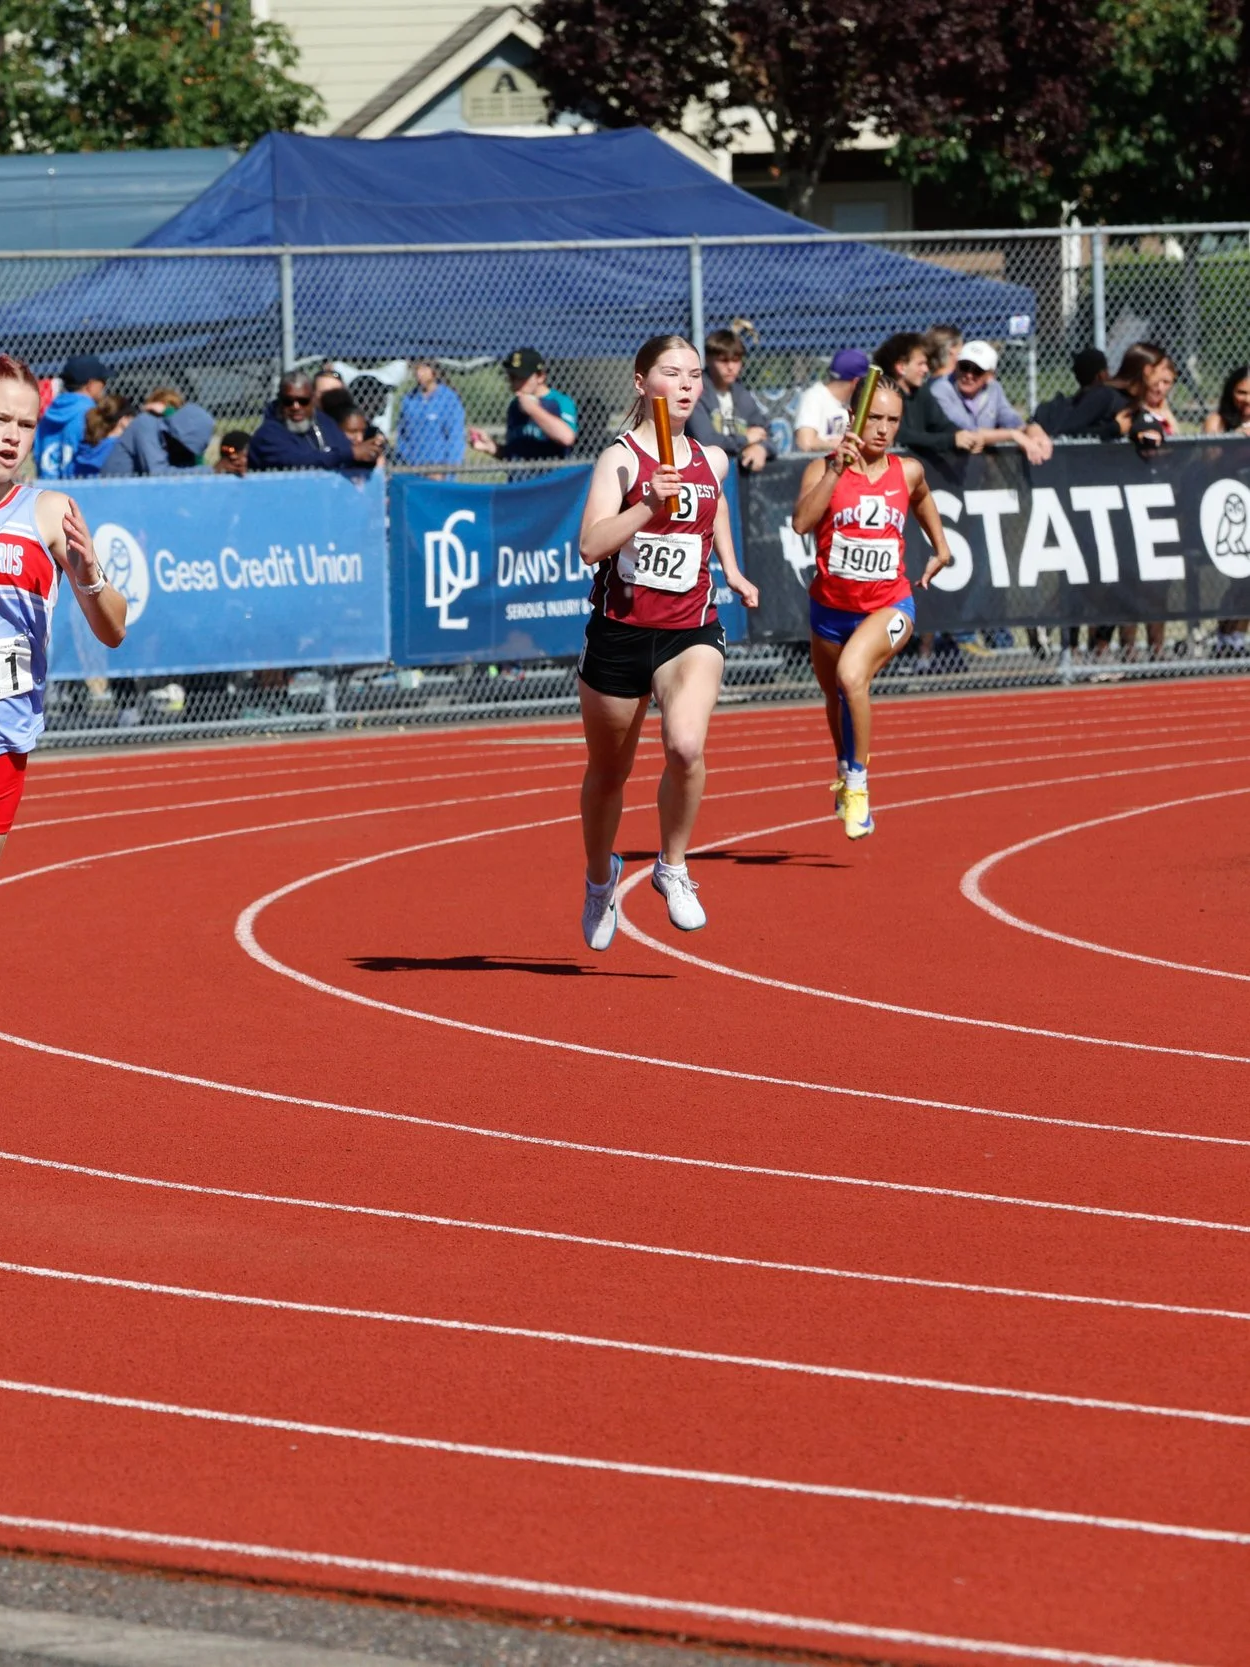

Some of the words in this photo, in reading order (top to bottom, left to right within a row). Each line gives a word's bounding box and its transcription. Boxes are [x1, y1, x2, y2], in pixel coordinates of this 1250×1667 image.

[492, 71, 520, 93] A
[677, 485, 692, 519] 3
[865, 499, 879, 527] 2
[922, 483, 1186, 592] STATE
[154, 549, 218, 592] Gesa
[219, 544, 297, 589] Credit
[298, 543, 362, 586] Union
[497, 546, 560, 588] DAVIS
[564, 541, 600, 582] LA
[636, 543, 686, 580] 362
[839, 545, 892, 573] 1900
[890, 618, 905, 643] 2
